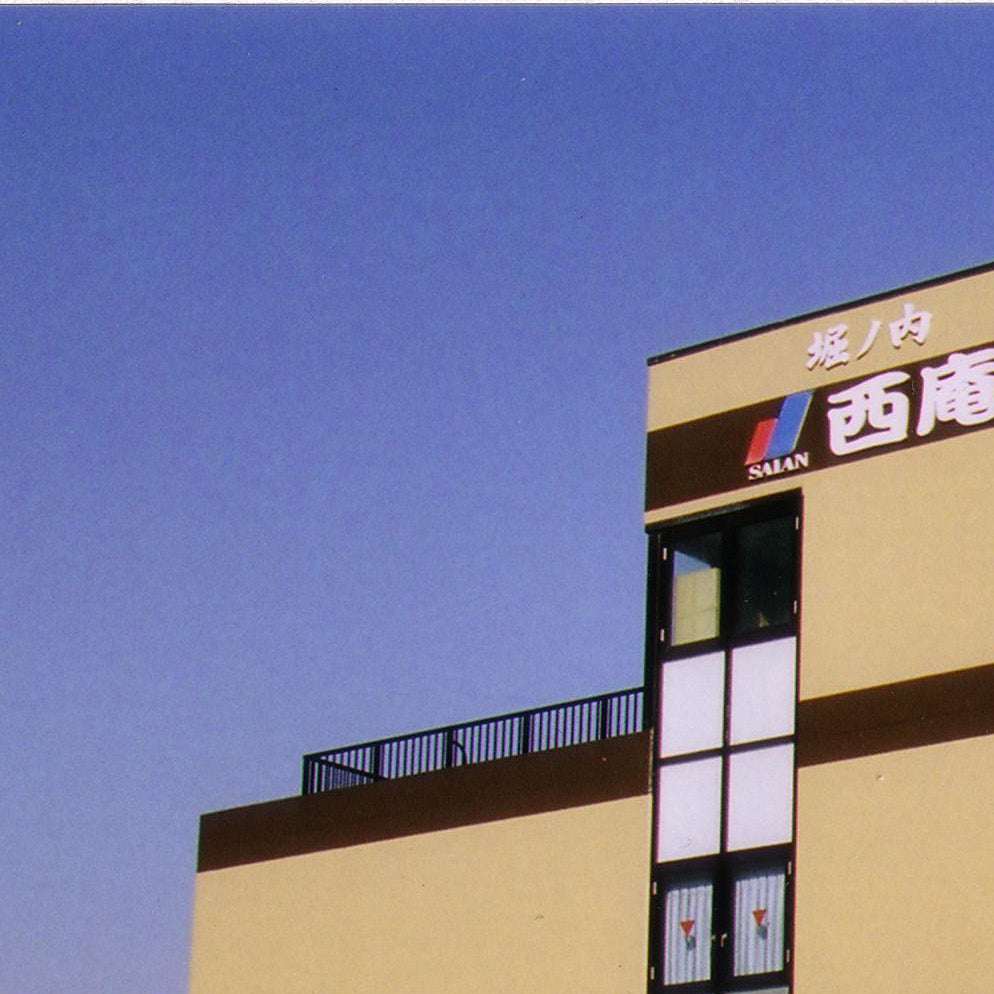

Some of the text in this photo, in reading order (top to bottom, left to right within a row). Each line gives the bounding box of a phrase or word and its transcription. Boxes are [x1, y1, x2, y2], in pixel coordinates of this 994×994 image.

[805, 303, 932, 371] 堀ノ内
[748, 452, 810, 481] SAIAN
